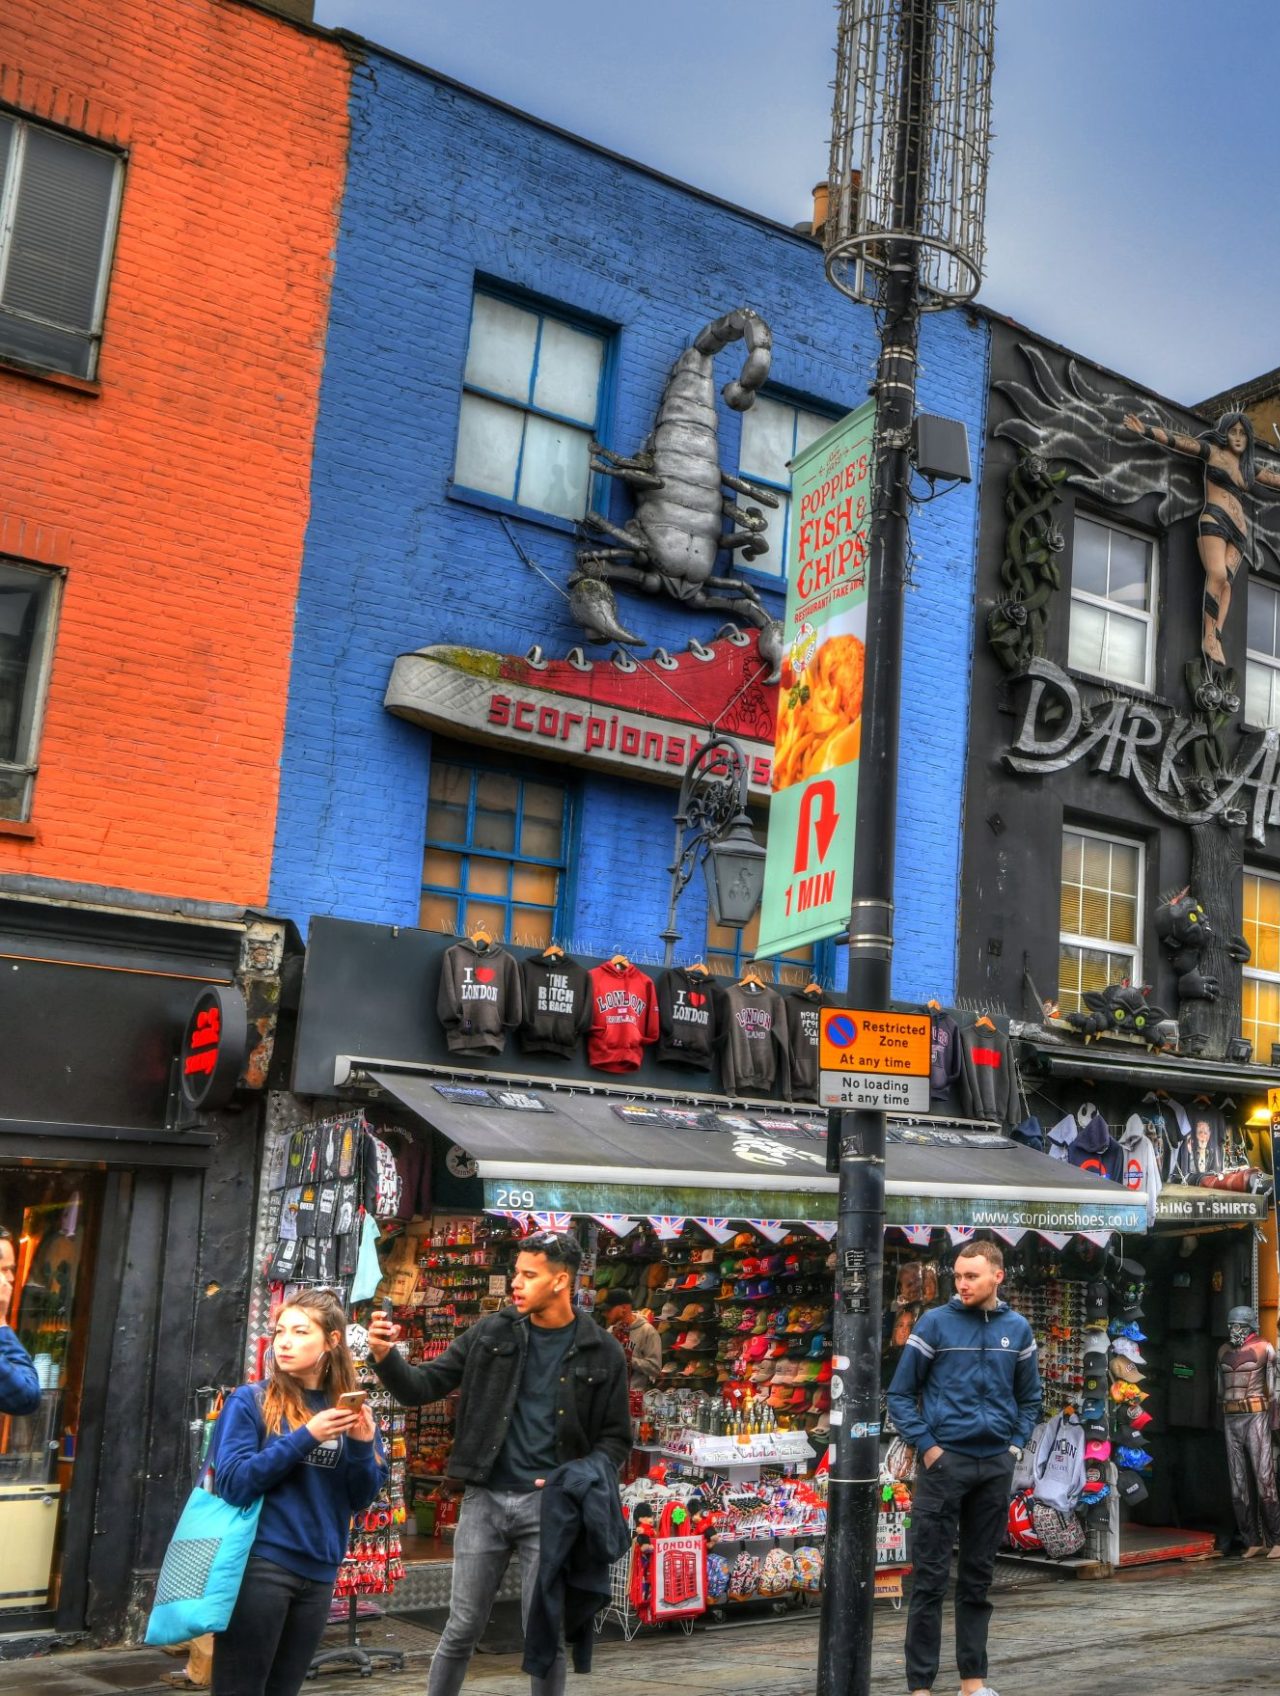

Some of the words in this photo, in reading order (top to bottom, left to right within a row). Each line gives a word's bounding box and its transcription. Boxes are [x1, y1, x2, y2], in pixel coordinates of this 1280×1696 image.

[800, 454, 868, 521] POPPIE'S
[797, 497, 853, 563] FISH
[797, 531, 869, 599] CHIPS
[1001, 656, 1212, 824] DARK
[785, 885, 793, 917] 1
[797, 870, 836, 913] MIN
[464, 967, 474, 983] I
[547, 974, 569, 989] THE
[461, 984, 498, 1001] LONDON
[538, 987, 574, 1003] BITCH
[677, 991, 686, 1007] I
[538, 1000, 548, 1011] IS
[549, 1001, 573, 1014] BACK
[597, 990, 647, 1017] LONDON
[673, 1006, 709, 1025] LONDON
[735, 1008, 771, 1031] LONDON
[863, 1021, 926, 1036] Restricted
[880, 1036, 908, 1048] Zone
[840, 1054, 854, 1065] At
[859, 1057, 880, 1069] any
[885, 1057, 911, 1069] time
[843, 1077, 860, 1089] No
[864, 1079, 909, 1094] loading
[840, 1092, 853, 1102] at
[857, 1095, 879, 1106] any
[883, 1094, 910, 1106] time
[496, 1190, 534, 1208] 269
[1196, 1202, 1257, 1215] T-SHIRTS
[971, 1211, 1140, 1229] www.scorpionshoes.co.uk
[657, 1541, 701, 1553] LONDON
